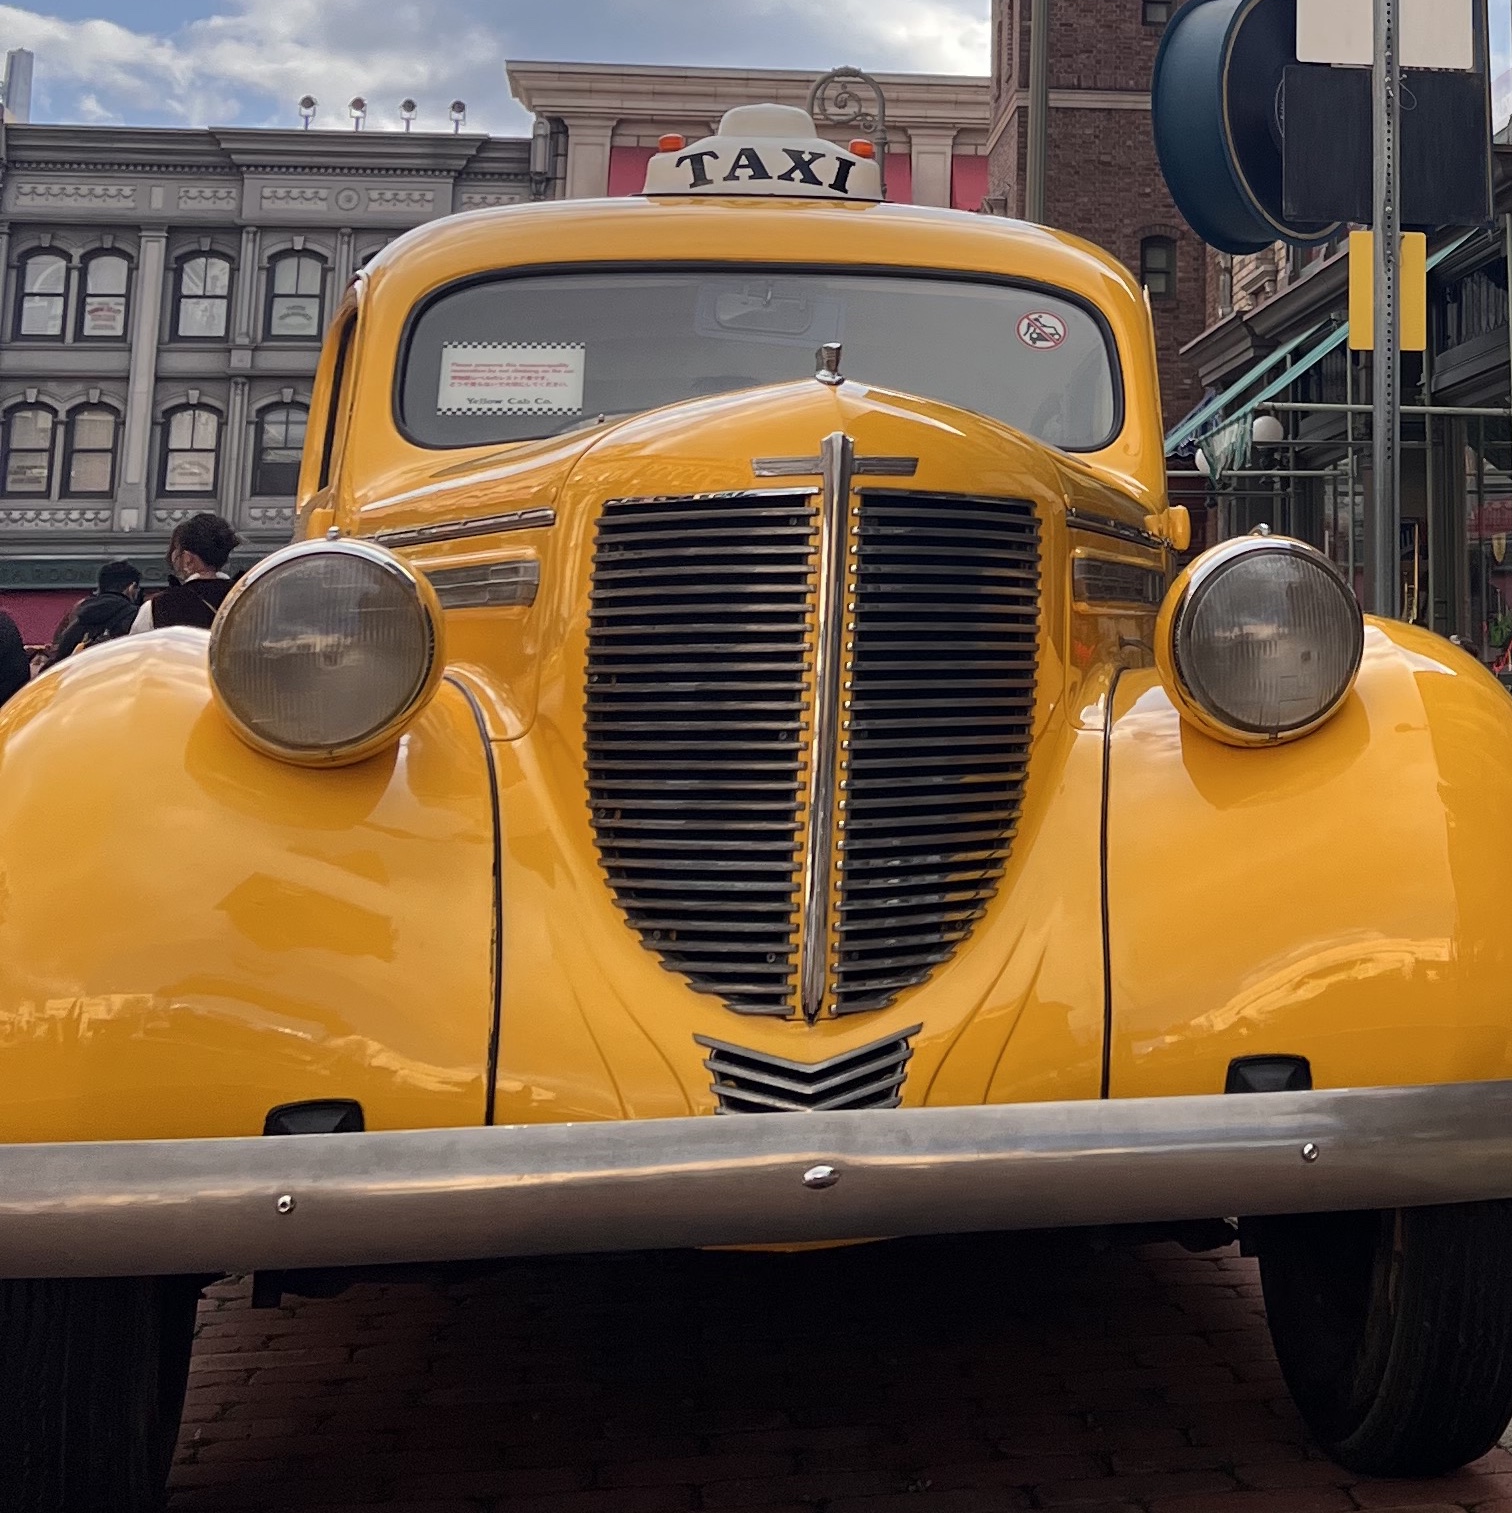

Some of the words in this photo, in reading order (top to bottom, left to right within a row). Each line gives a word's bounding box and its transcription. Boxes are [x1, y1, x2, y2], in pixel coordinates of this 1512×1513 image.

[675, 147, 856, 194] TAXI
[467, 397, 503, 405] Yellow
[507, 397, 531, 405] Cab
[534, 397, 553, 405] Co.
